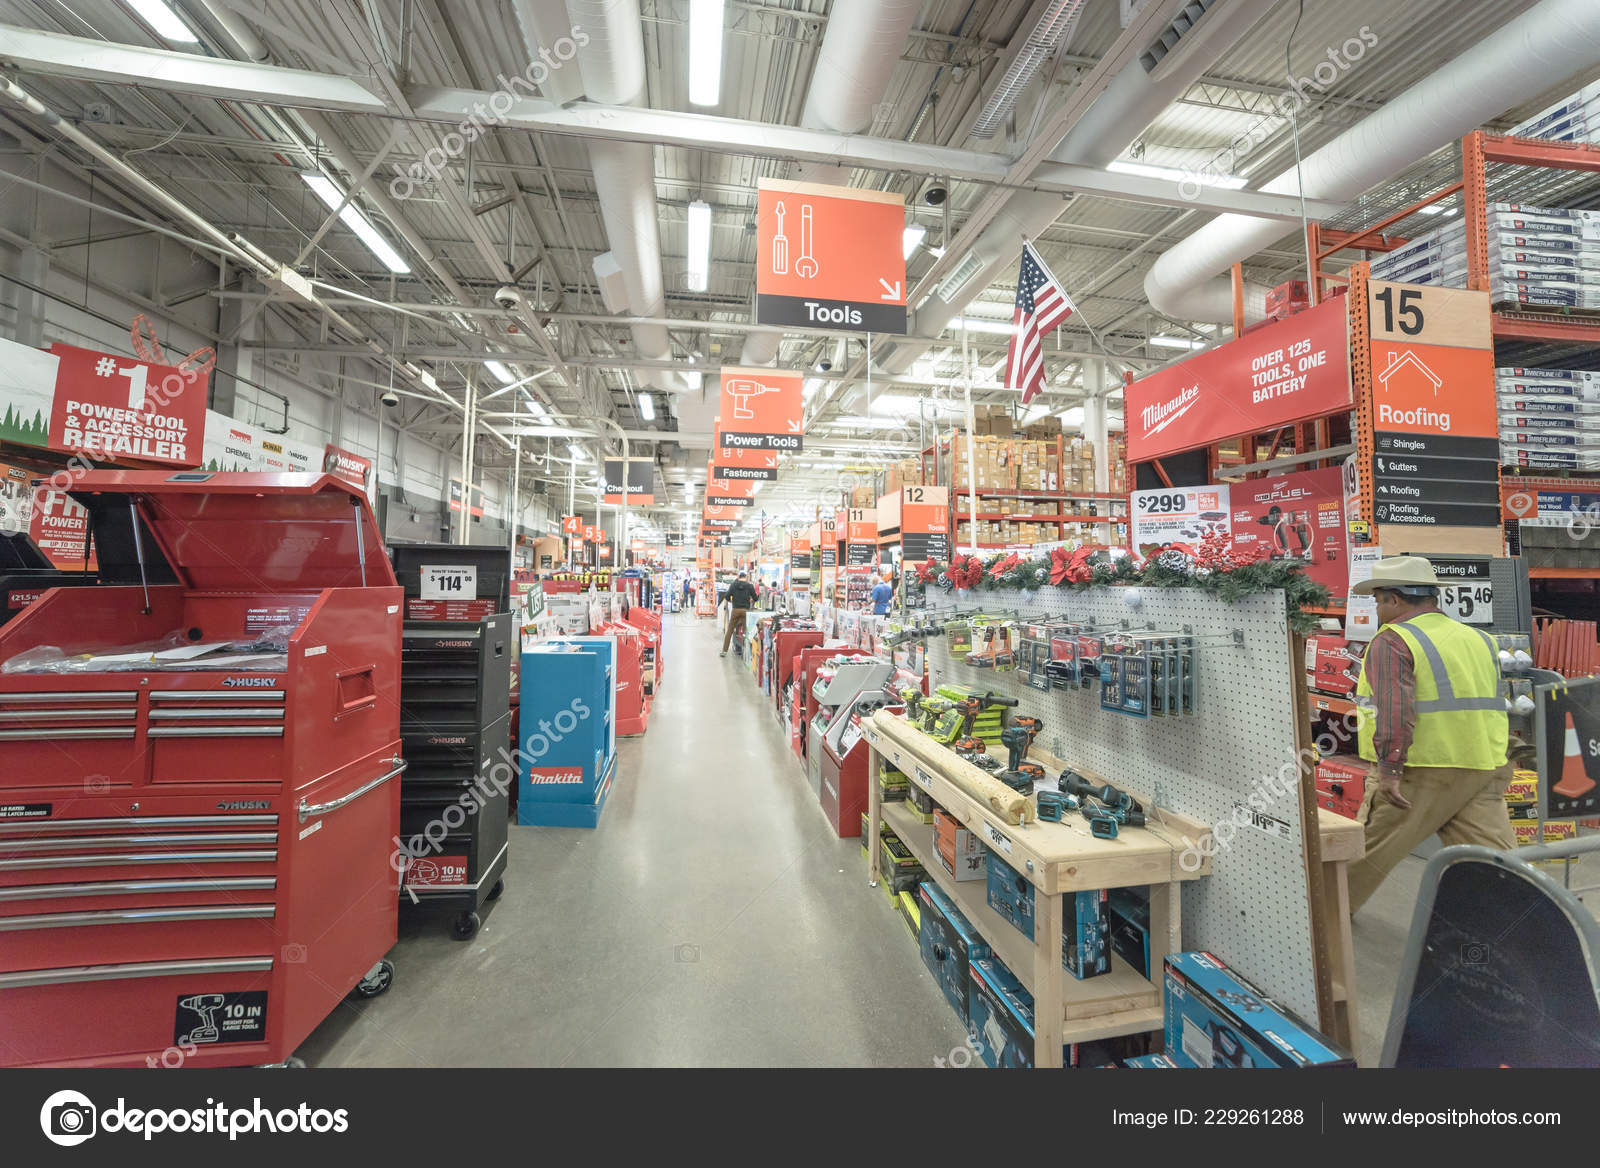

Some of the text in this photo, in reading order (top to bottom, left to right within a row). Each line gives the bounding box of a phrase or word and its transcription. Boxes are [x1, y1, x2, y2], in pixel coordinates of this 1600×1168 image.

[805, 302, 862, 325] Tools
[1375, 286, 1425, 336] 15
[1252, 338, 1311, 372] OVER 125
[1252, 350, 1326, 387] TOOLS, ONE
[95, 356, 149, 411] #1
[1253, 375, 1308, 404] BATTERY
[1140, 384, 1199, 431] Milwaukee
[66, 400, 188, 432] POWER TOOL
[1379, 404, 1450, 431] Roofing
[65, 415, 187, 443] & ACCESSORY
[63, 428, 187, 461] RETAILER
[726, 434, 798, 447] Power Tools
[1393, 439, 1425, 450] Shingles
[225, 446, 252, 460] DREMEL
[341, 456, 366, 473] HUSKY
[1389, 462, 1418, 472] Gutters
[723, 468, 768, 479] Fasteners
[607, 484, 643, 493] Chekout
[906, 488, 924, 502] 12
[1271, 488, 1312, 500] FUEL
[1390, 485, 1420, 496] Roofing
[715, 498, 748, 506] Hardware
[1138, 494, 1186, 513] $299
[852, 510, 863, 520] 11
[1389, 503, 1419, 515] Roofing
[42, 516, 82, 529] POWER
[567, 518, 577, 531] 4
[1389, 514, 1435, 523] Accessories
[824, 521, 835, 530] 10
[584, 527, 593, 539] 5
[793, 531, 799, 539] 9
[1354, 554, 1362, 562] 24
[1432, 564, 1477, 577] Starting At
[438, 576, 462, 591] 114
[236, 678, 276, 687] HUSKY
[1318, 768, 1352, 780] Milwaukee
[231, 800, 271, 810] HUSKY
[441, 866, 466, 876] 10 IN
[224, 1004, 262, 1018] 10 IN
